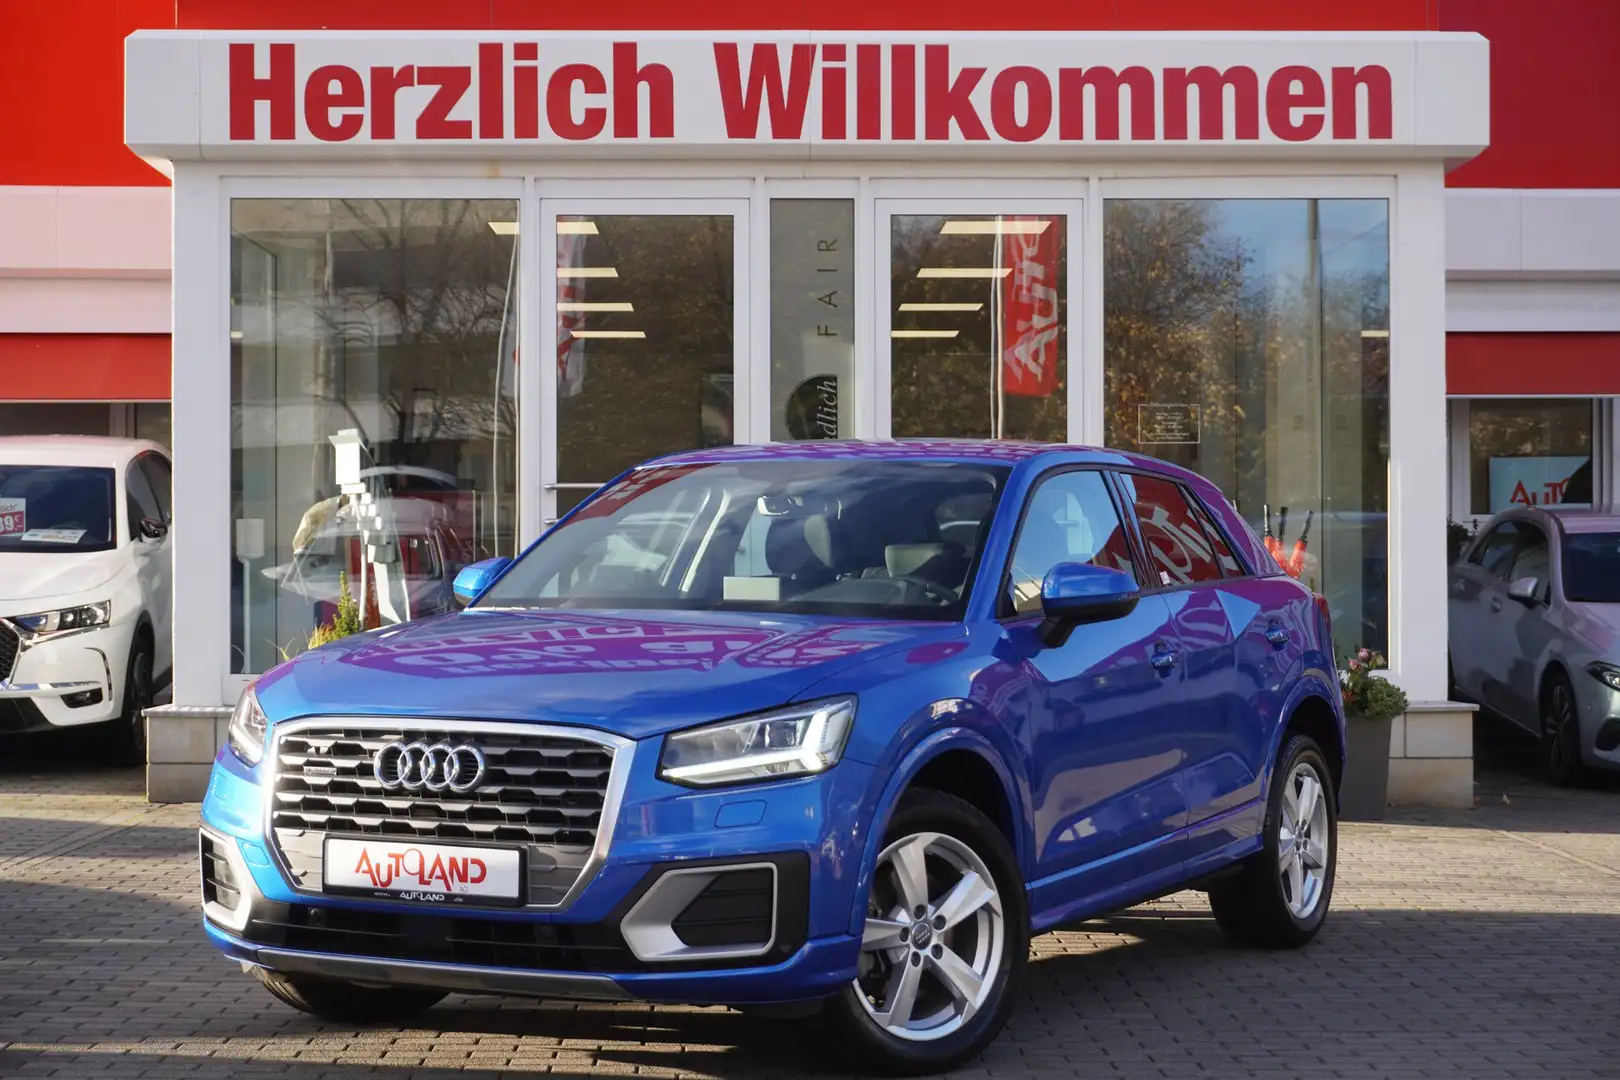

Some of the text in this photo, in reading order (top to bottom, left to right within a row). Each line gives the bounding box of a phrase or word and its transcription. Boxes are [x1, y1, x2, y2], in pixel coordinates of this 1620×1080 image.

[230, 42, 1392, 142] Herzlich Willkommen
[817, 238, 838, 336] FAIR
[815, 379, 837, 439] dlich
[355, 848, 487, 892] AUTOLAND
[399, 890, 445, 902] AUTOLAND
